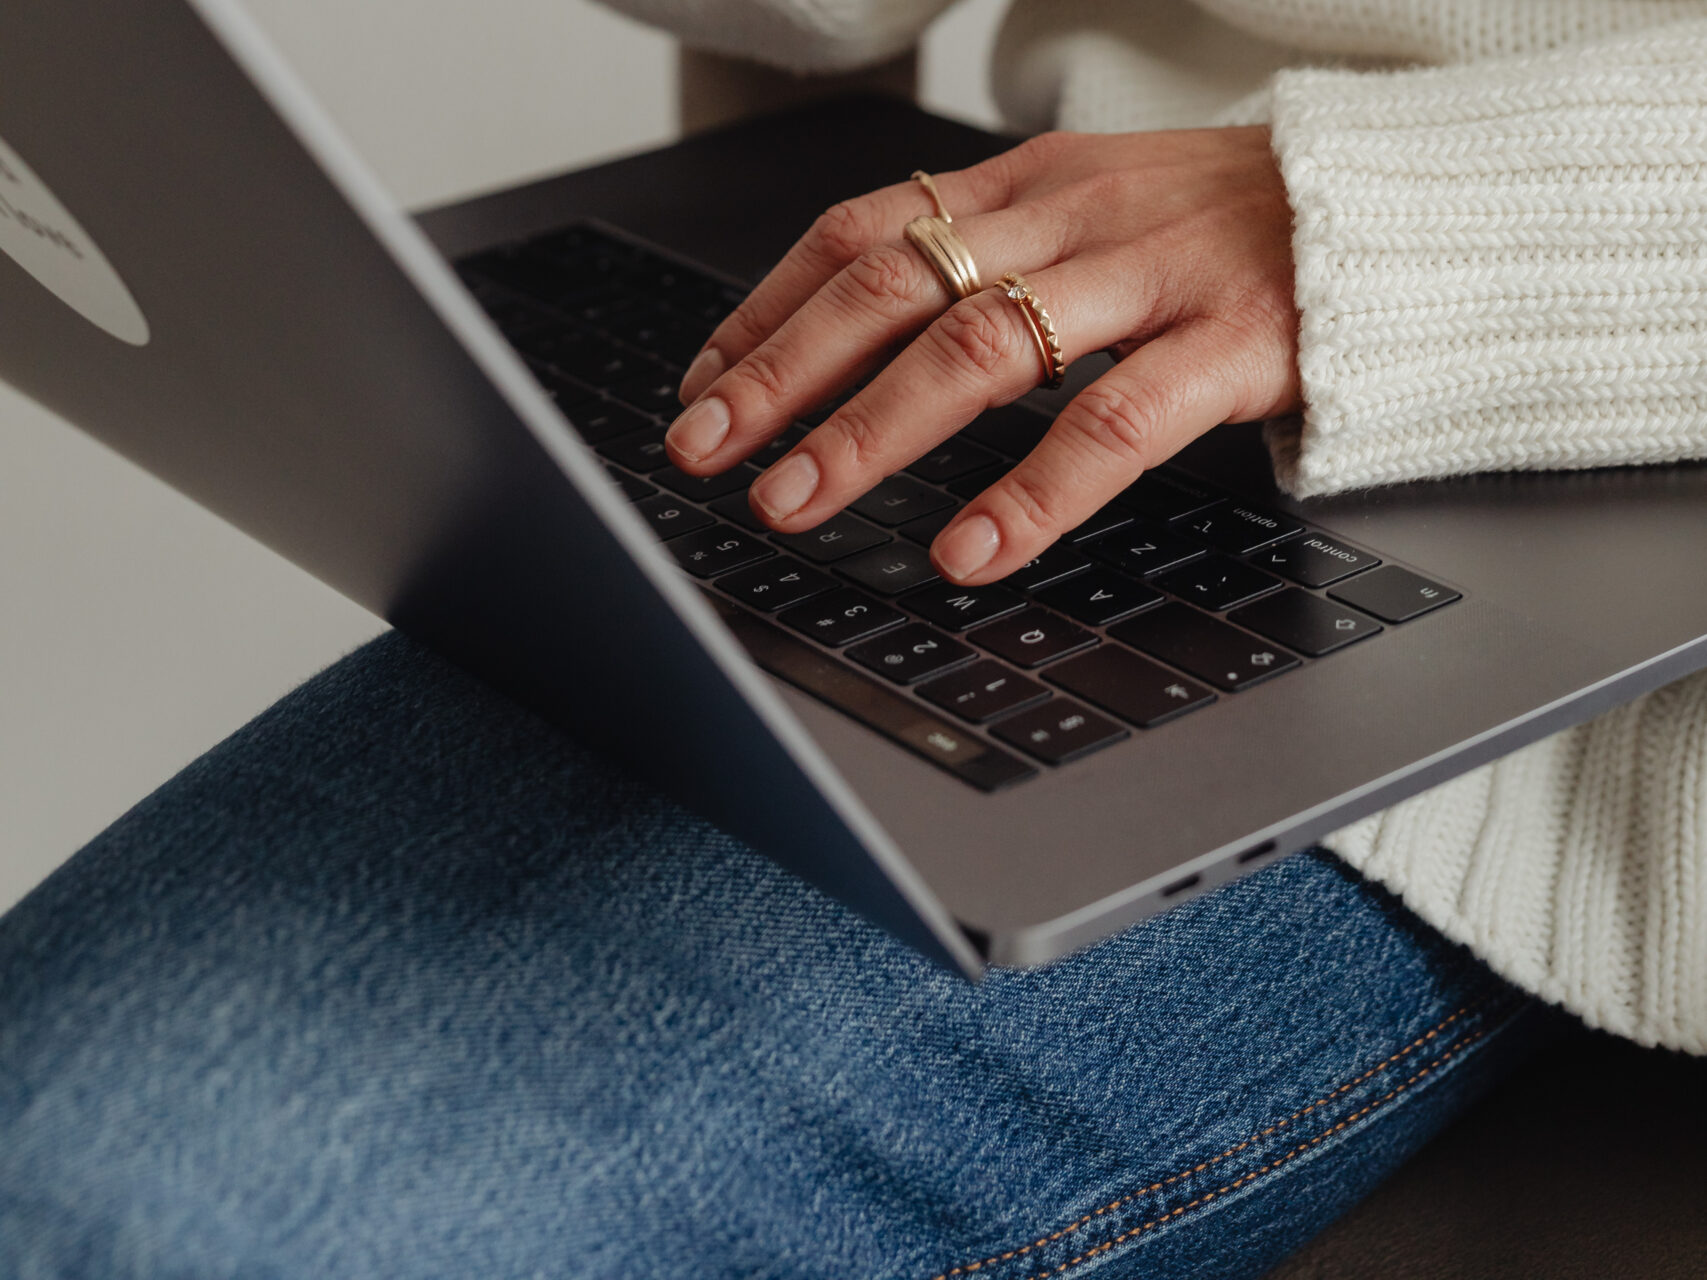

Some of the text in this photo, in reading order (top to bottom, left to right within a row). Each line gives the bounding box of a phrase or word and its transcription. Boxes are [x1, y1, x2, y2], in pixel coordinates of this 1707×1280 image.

[883, 497, 908, 507] F
[657, 509, 680, 521] 6
[1233, 507, 1278, 530] option
[819, 530, 843, 543] R
[716, 539, 740, 552] 5
[1130, 542, 1157, 556] Z
[1303, 537, 1358, 564] control
[882, 562, 908, 575] E
[778, 572, 801, 584] 4
[1089, 588, 1114, 602] A
[1420, 587, 1439, 599] fn
[945, 594, 978, 611] W
[844, 605, 868, 618] 3
[1020, 629, 1045, 644] Q
[913, 640, 938, 655] 2
